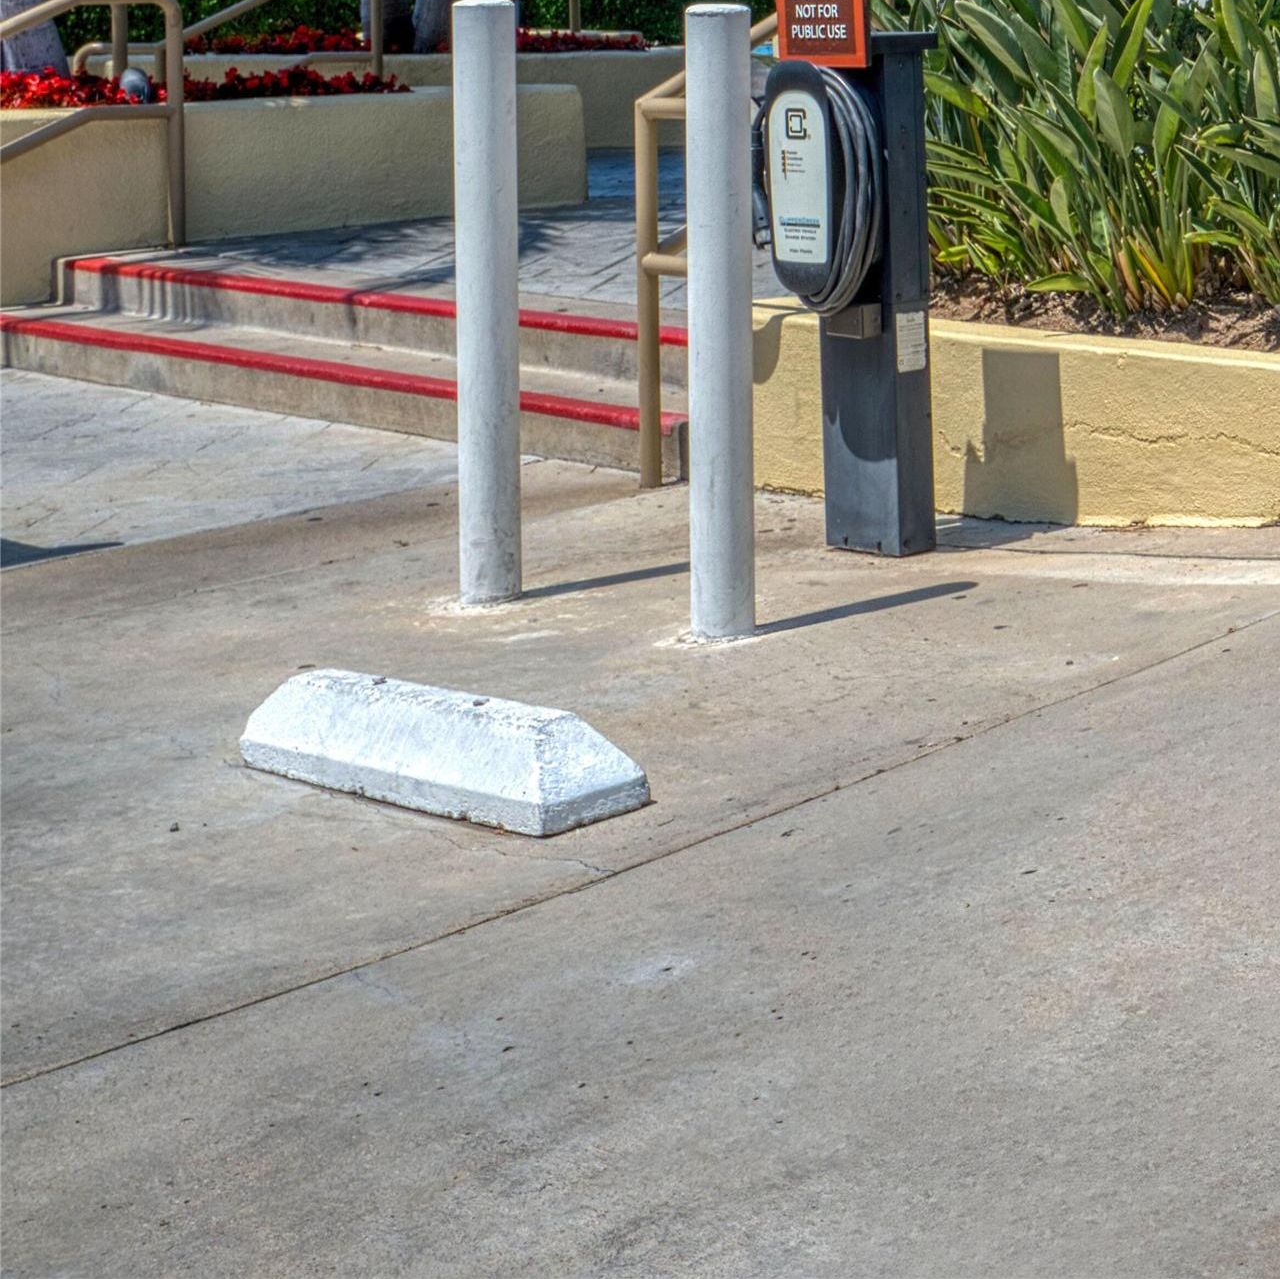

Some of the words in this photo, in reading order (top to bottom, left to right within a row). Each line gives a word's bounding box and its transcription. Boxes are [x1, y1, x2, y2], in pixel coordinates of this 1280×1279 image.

[795, 3, 816, 19] NOT
[817, 3, 839, 19] FOR
[791, 24, 826, 40] PUBLIC
[827, 24, 848, 40] USE
